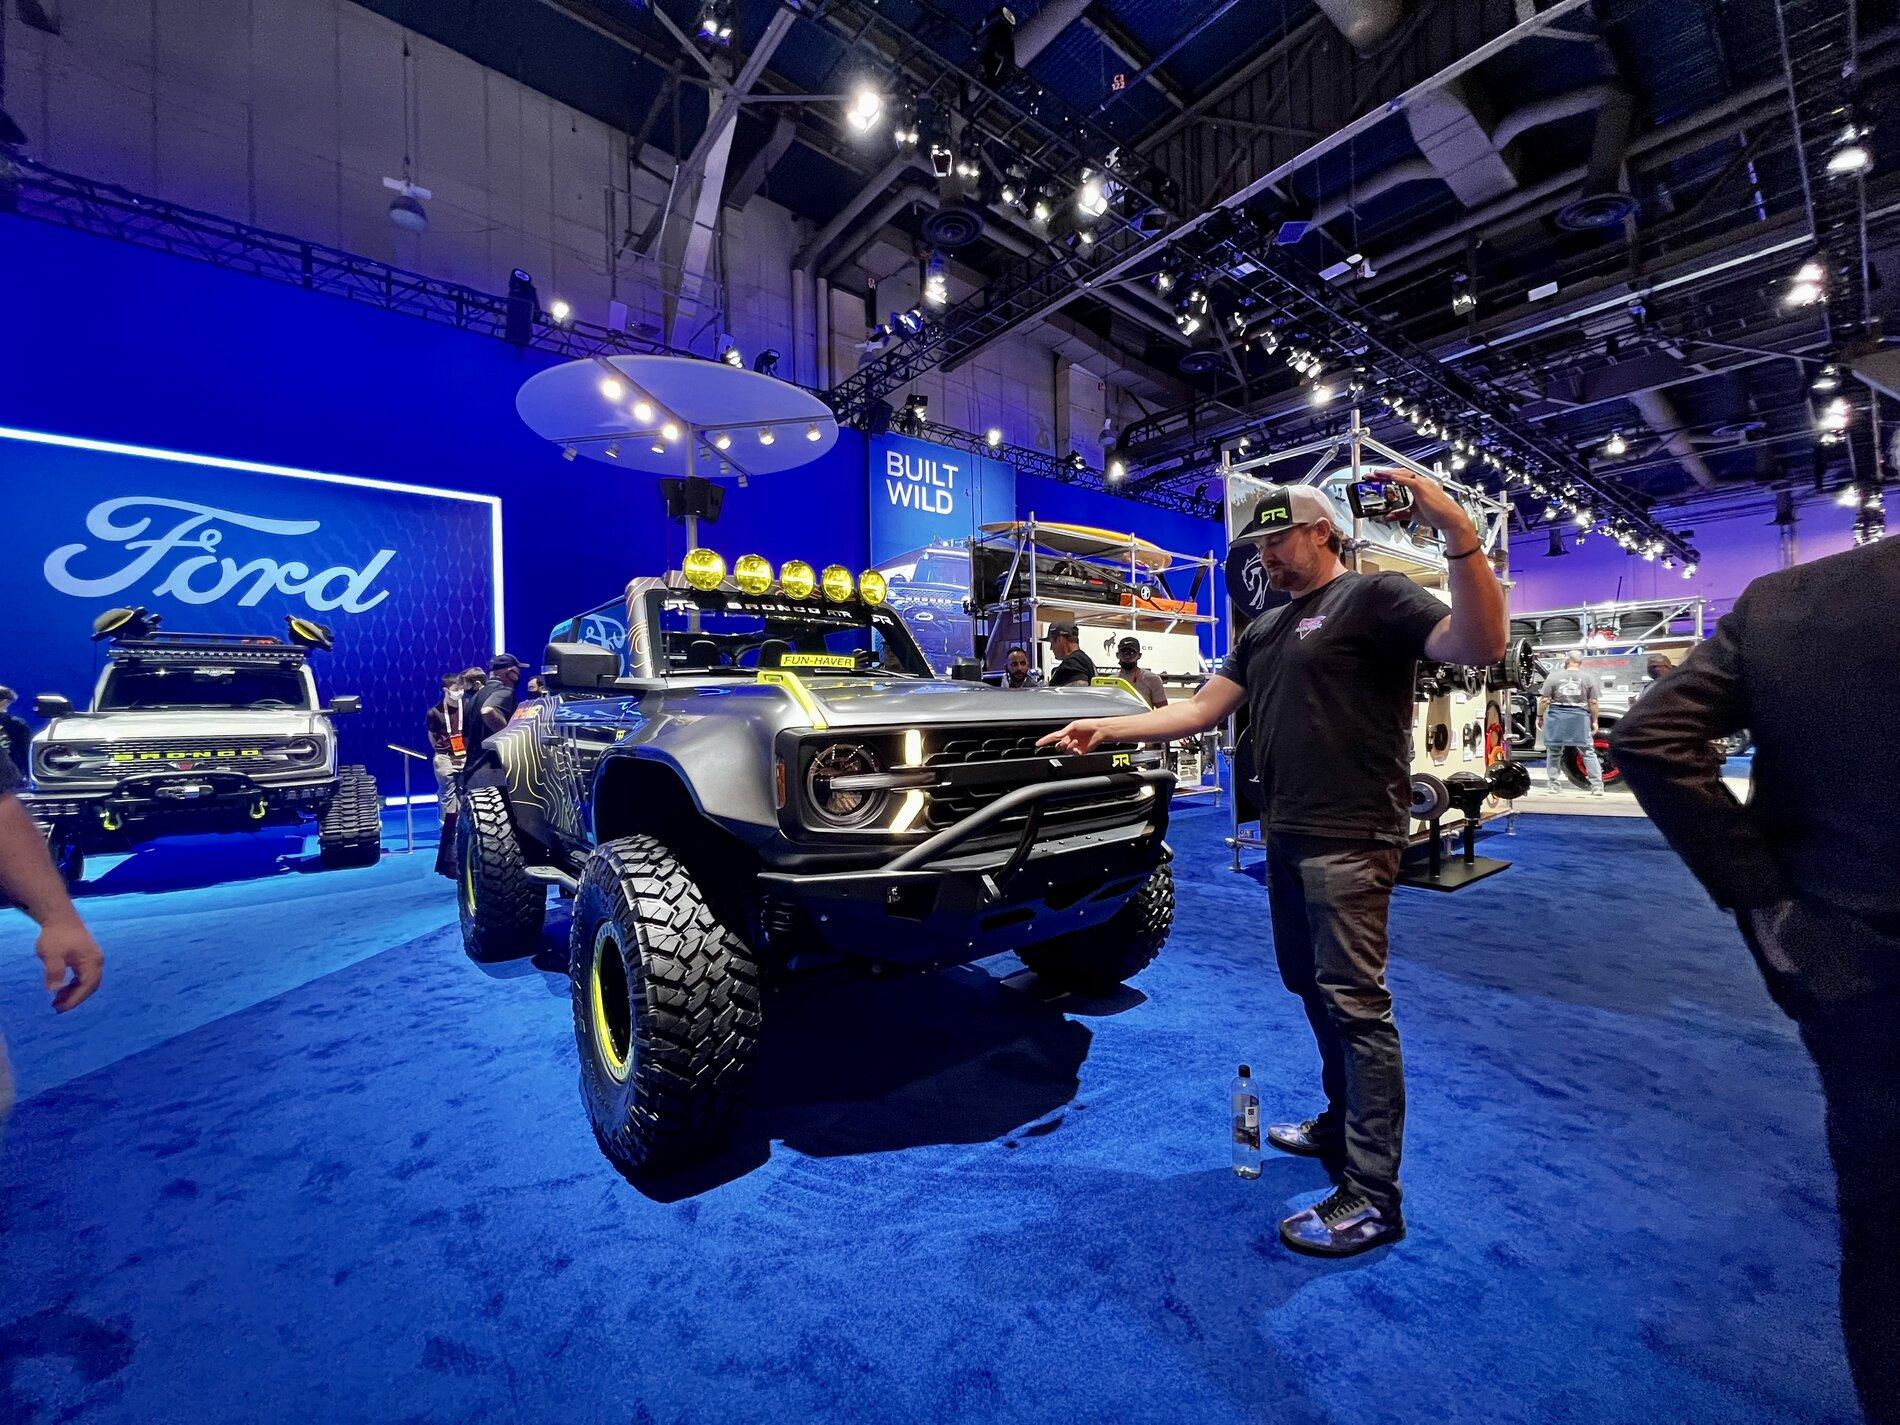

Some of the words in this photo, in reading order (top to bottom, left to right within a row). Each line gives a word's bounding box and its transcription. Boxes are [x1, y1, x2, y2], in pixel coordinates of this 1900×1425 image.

[886, 450, 959, 489] BUILT
[886, 478, 953, 515] WILD
[44, 496, 396, 613] Ford
[726, 602, 821, 614] BRONCO
[826, 609, 853, 618] RTR
[783, 655, 852, 667] FUN-HAVER
[113, 749, 259, 761] BRONCO
